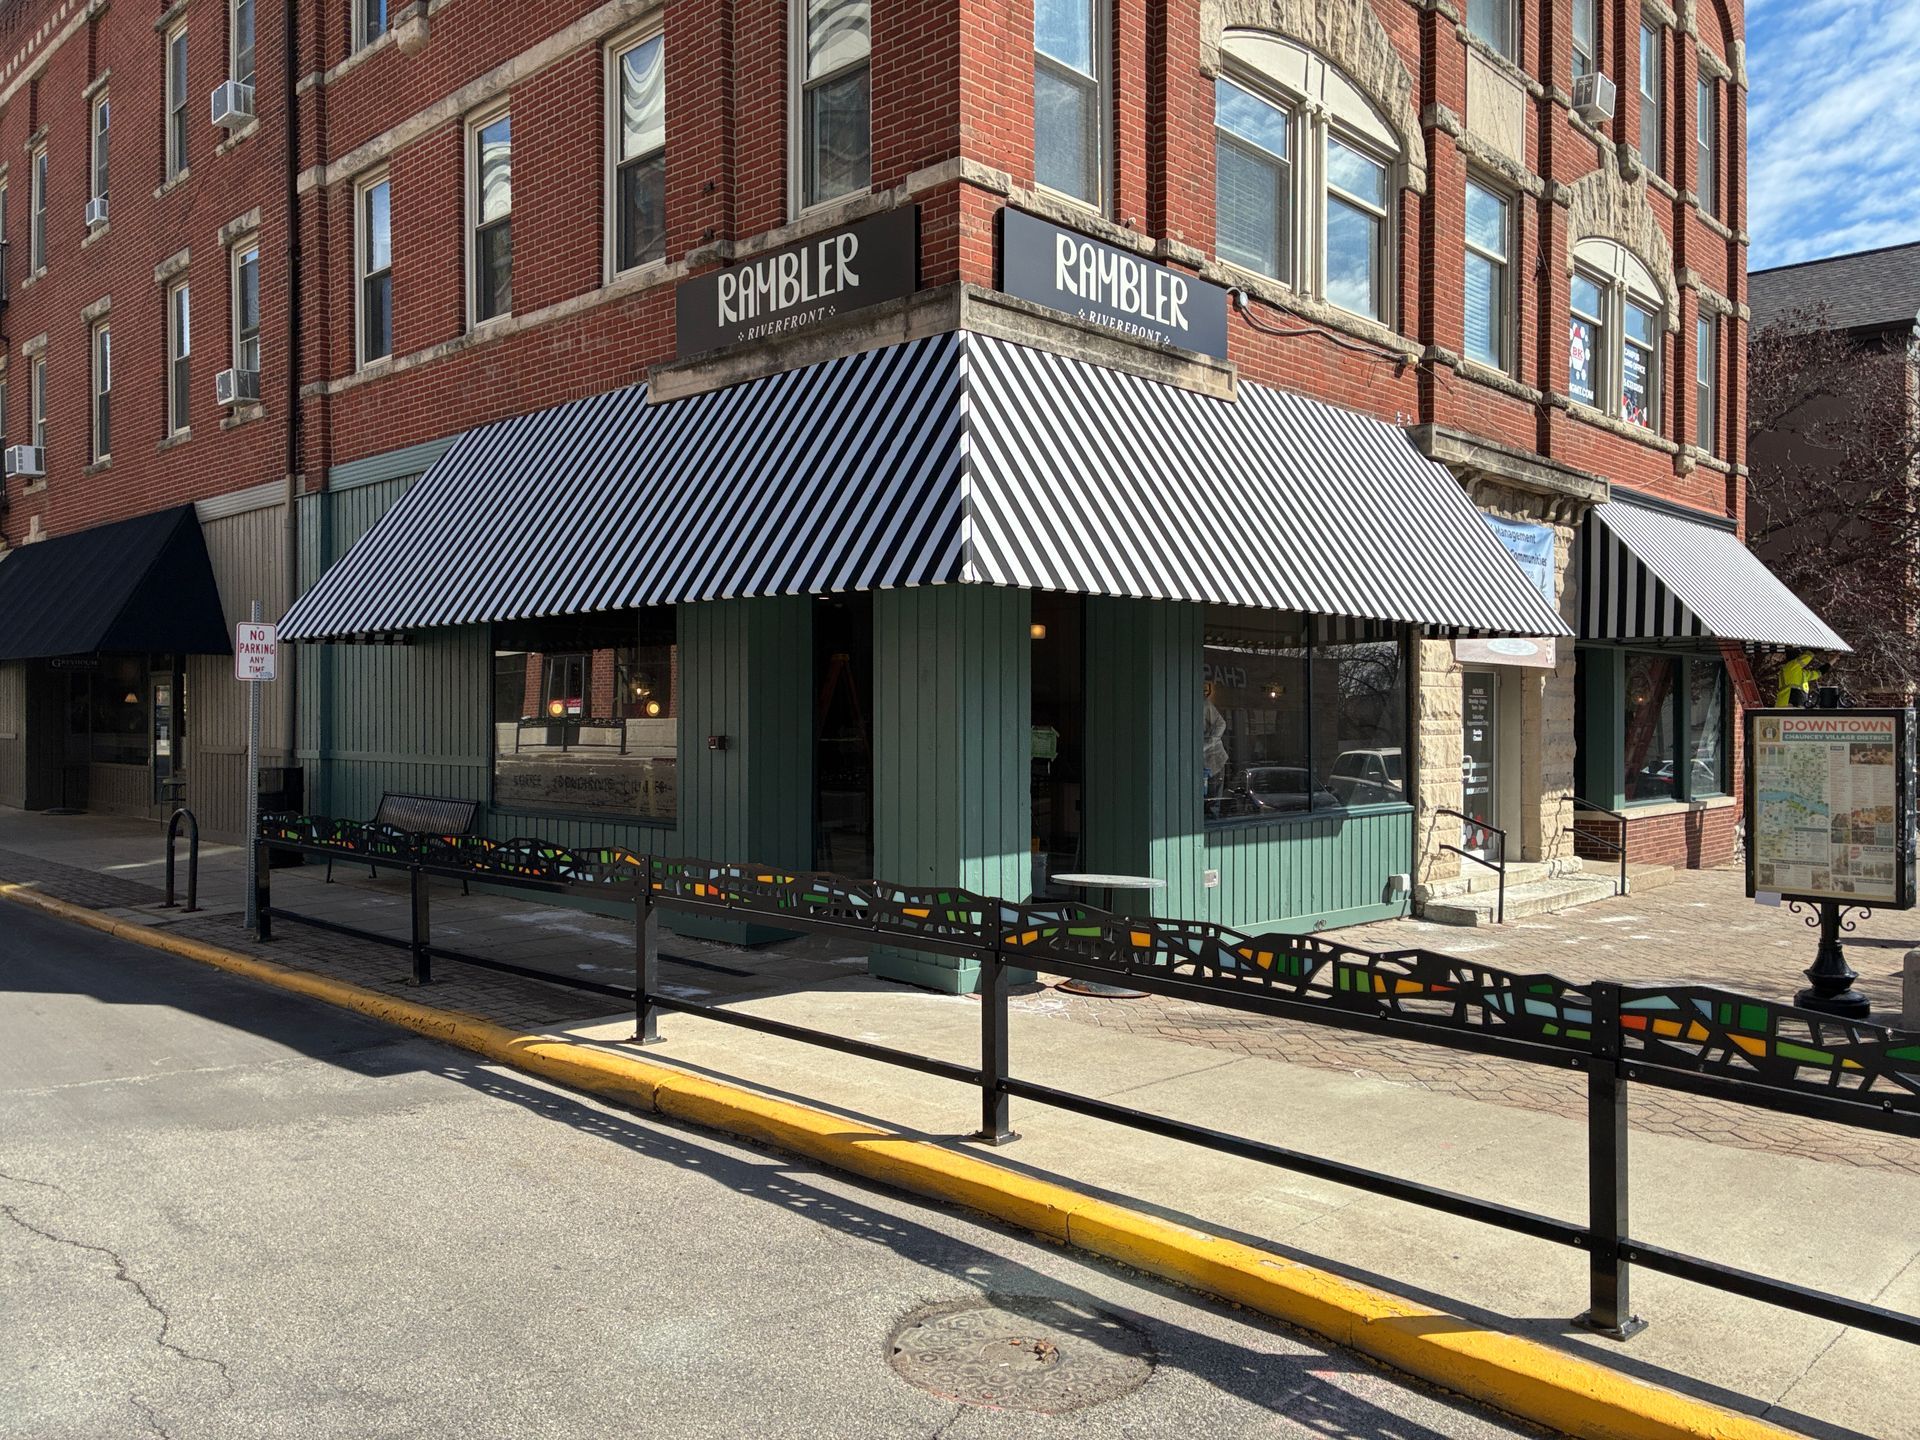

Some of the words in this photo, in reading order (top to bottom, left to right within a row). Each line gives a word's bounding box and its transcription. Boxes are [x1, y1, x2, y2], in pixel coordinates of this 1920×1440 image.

[718, 232, 860, 327] RAMBLER
[1056, 232, 1189, 331] RAMBLER
[747, 307, 825, 340] RIVERFRONT
[1089, 310, 1162, 342] RIVERFRONT
[250, 630, 265, 641] NO
[240, 643, 275, 655] PARKING
[249, 656, 265, 664] ANY
[1783, 720, 1892, 732] DOWNTOWN
